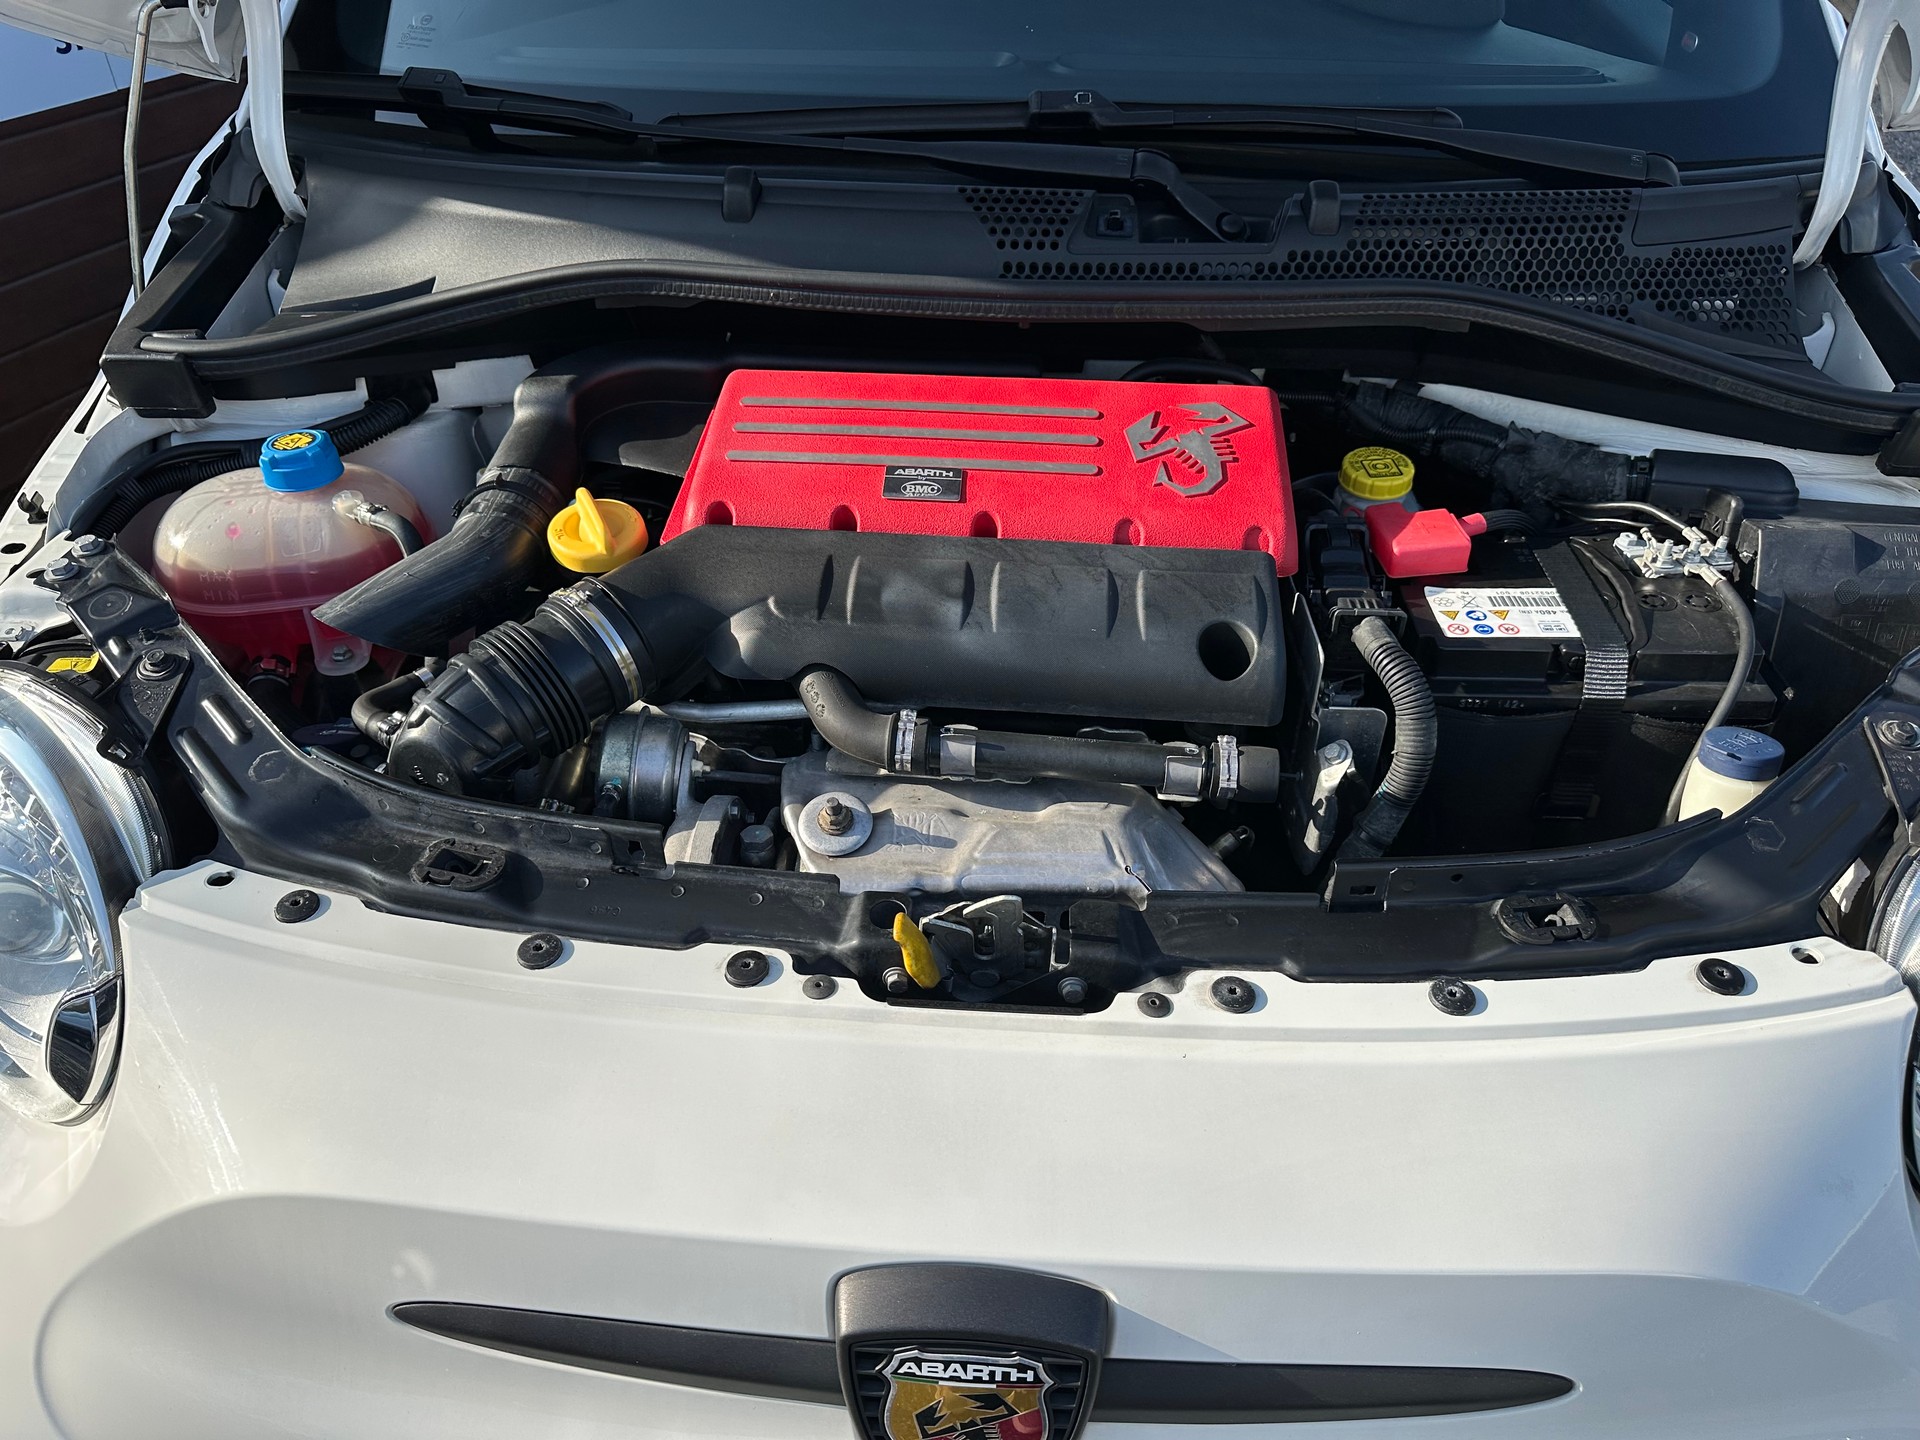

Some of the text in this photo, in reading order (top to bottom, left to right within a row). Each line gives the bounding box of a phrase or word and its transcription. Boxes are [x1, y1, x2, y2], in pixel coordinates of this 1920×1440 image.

[894, 468, 953, 477] ABARTH
[905, 484, 938, 494] BMC
[199, 567, 234, 582] MAX
[203, 589, 240, 601] MIN
[897, 1361, 1035, 1382] ABARTH
